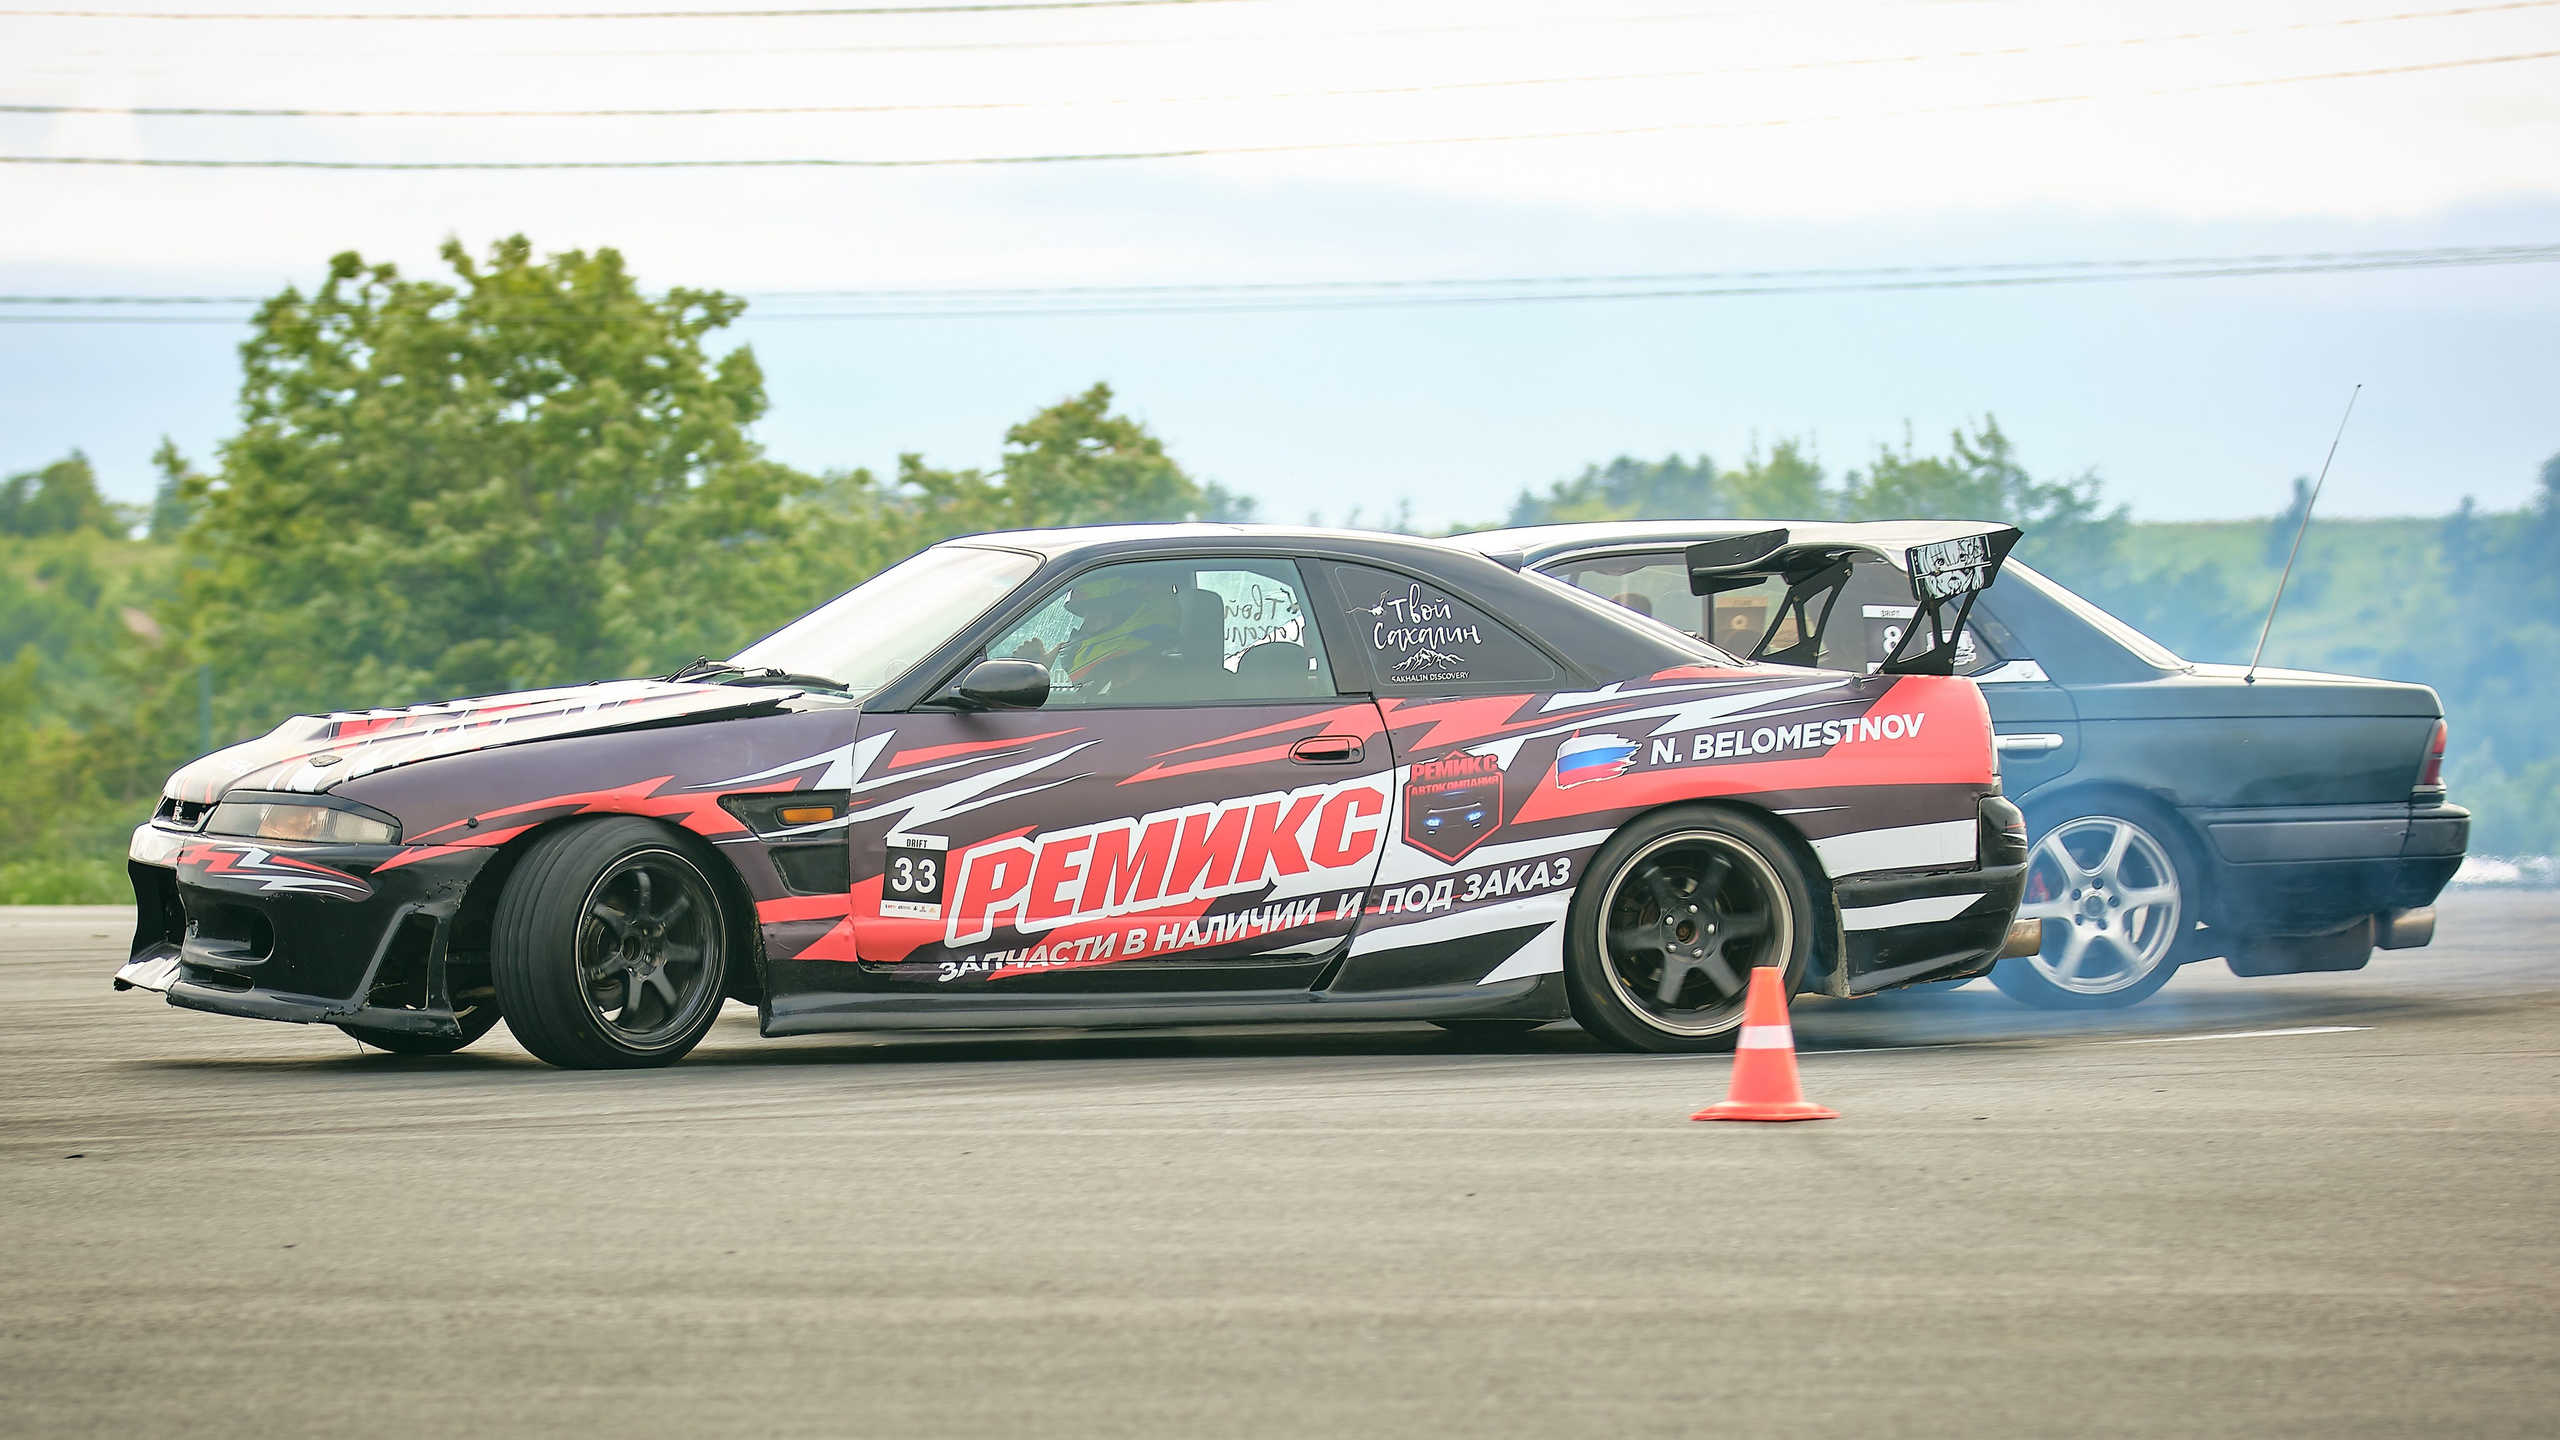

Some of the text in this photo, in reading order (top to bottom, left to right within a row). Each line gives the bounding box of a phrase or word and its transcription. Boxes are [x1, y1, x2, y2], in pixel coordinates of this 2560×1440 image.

[1387, 583, 1452, 624] Твой
[1373, 622, 1482, 652] Сахалин
[1391, 671, 1470, 683] SAKHALIN DISCOVERY
[1650, 713, 1925, 765] N. BELOMESTNOV
[1410, 754, 1498, 783] РЕМИКС
[1410, 775, 1499, 796] АВТОКОМПАНИЯ
[906, 838, 928, 849] DRIFT
[891, 856, 938, 894] 33
[949, 783, 1388, 943] РЕМИКС
[937, 857, 1572, 983] ЗАПЧАСТИ В НАЛИЧИИ И ПОД ЗАКАЗ
